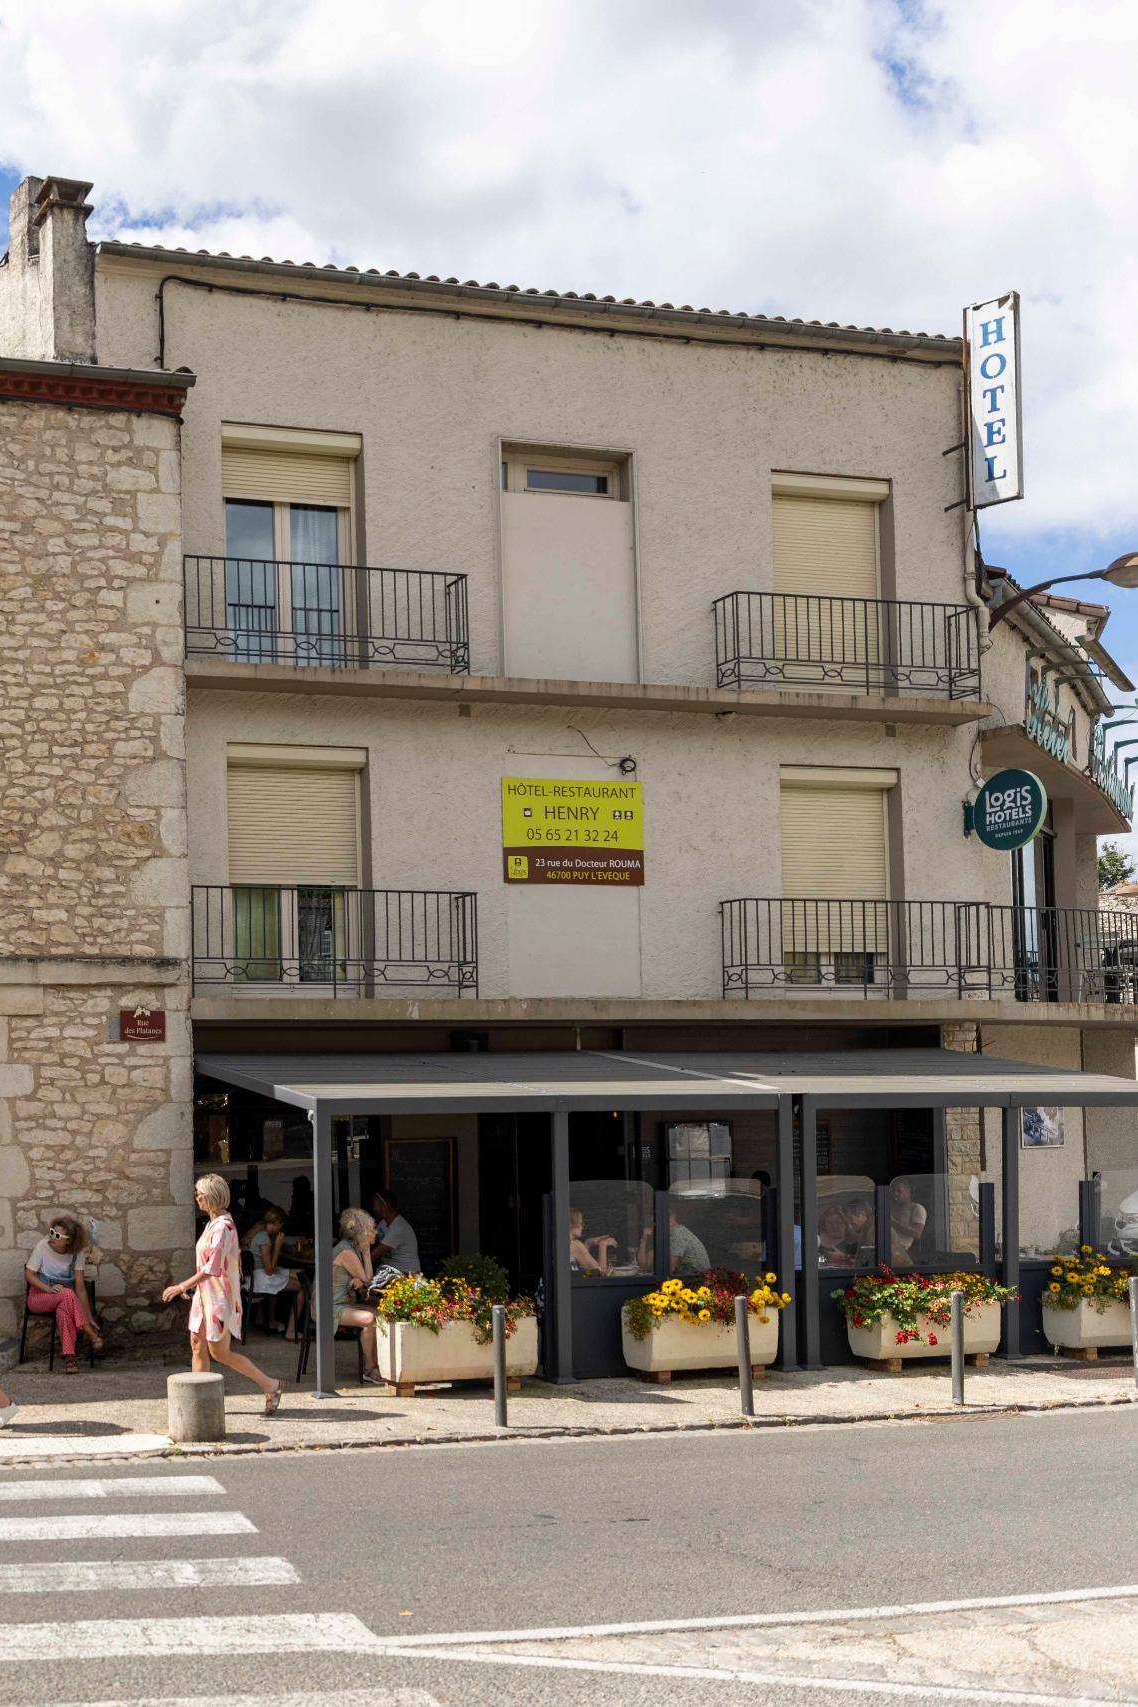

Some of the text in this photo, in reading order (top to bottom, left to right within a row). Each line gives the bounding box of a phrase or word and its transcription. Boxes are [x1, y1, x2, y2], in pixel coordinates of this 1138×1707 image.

[980, 316, 1007, 483] HOTEL
[508, 783, 636, 799] HÔTEL-RESTAURANT
[545, 806, 599, 820] HENRY
[986, 805, 1032, 824] HOTELS
[986, 818, 1032, 832] RESTAURANTS
[527, 828, 618, 842] 05 65 21 32 24
[536, 859, 545, 867] 23
[563, 859, 573, 867] du
[576, 860, 607, 868] Docteur
[610, 860, 640, 868] ROUMA
[547, 872, 571, 880] 46700
[574, 872, 588, 880] PUY
